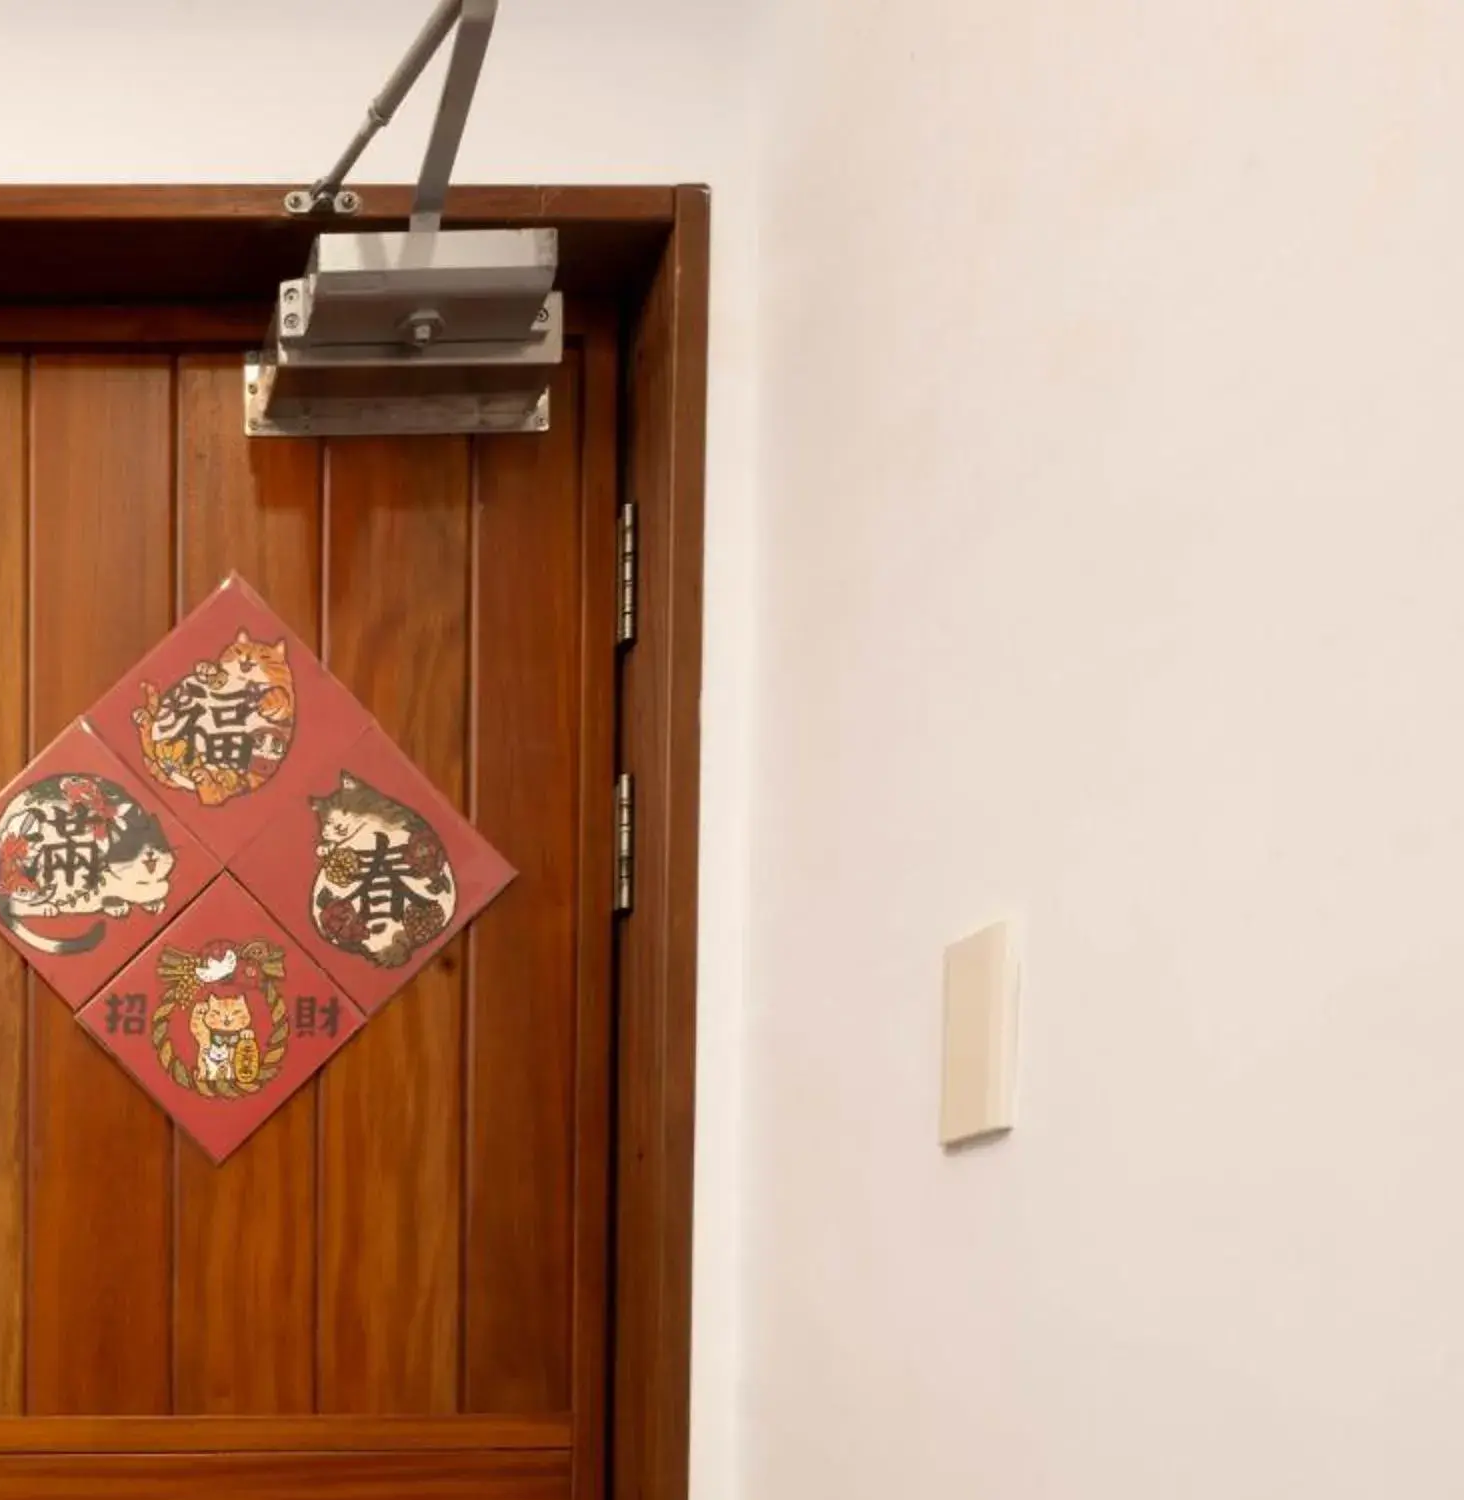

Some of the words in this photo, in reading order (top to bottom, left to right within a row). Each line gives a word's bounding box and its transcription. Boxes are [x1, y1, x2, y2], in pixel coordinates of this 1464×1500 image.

[172, 682, 253, 769] 福
[345, 832, 430, 923] 春
[105, 993, 146, 1035] 招
[295, 997, 340, 1038] 財
